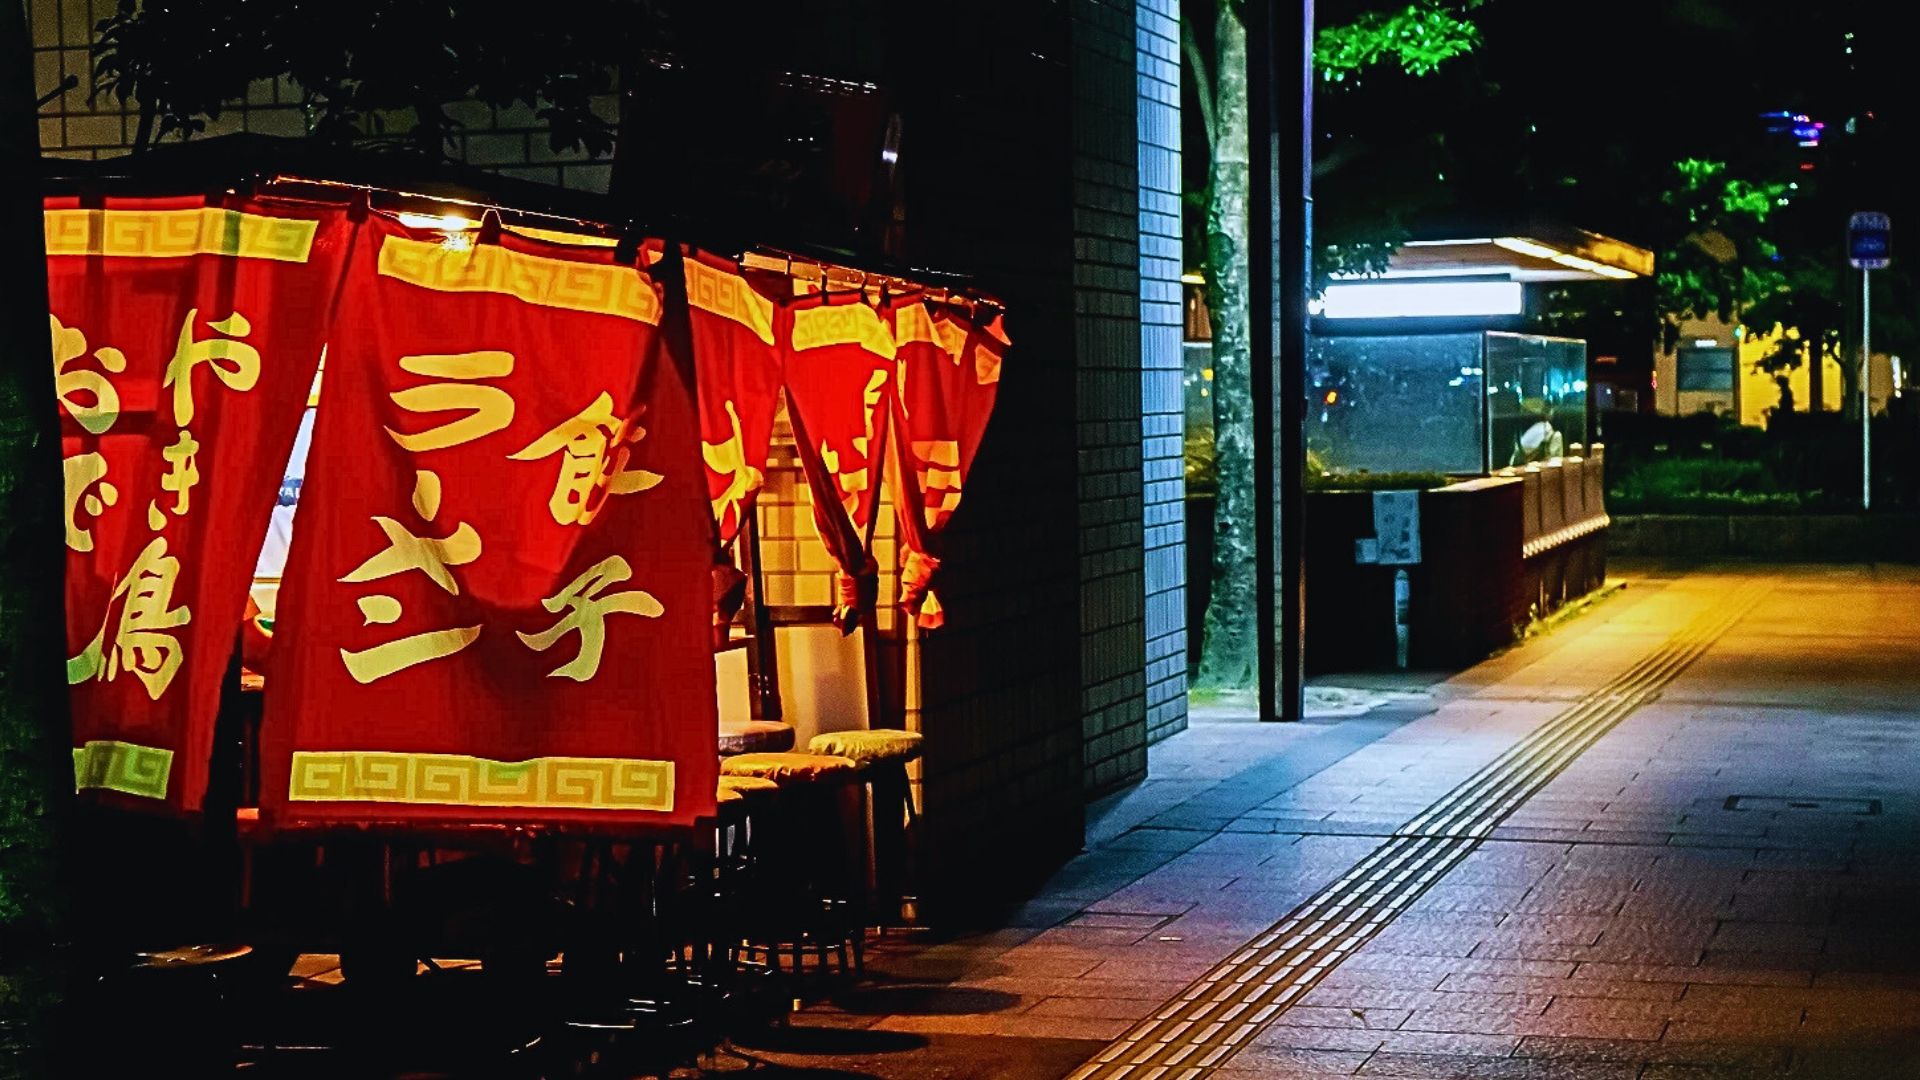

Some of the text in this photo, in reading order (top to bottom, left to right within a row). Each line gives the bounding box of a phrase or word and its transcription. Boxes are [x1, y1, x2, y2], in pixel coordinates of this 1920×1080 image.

[99, 308, 261, 700] やき鳥
[337, 350, 516, 684] ラーメン
[505, 390, 665, 682] 餃子
